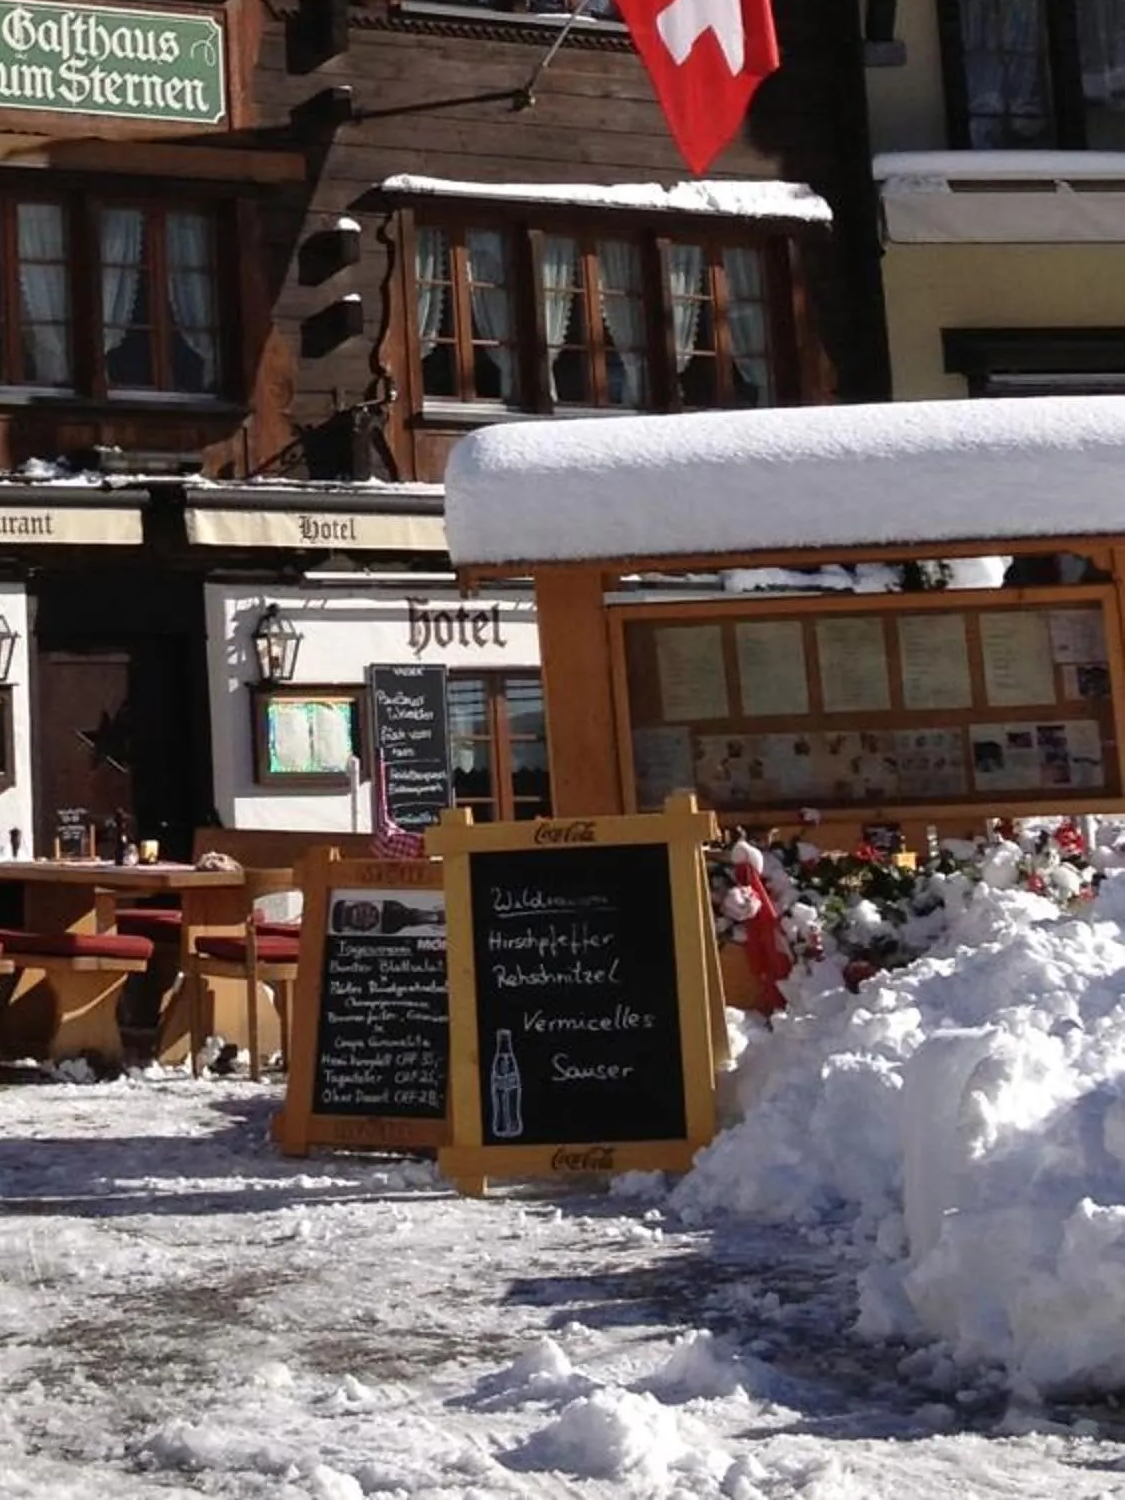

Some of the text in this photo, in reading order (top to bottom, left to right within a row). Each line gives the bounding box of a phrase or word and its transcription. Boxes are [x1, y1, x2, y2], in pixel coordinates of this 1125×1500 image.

[57, 55, 210, 112] Sternen
[298, 514, 357, 543] Hotel
[405, 596, 507, 658] Hotel
[488, 924, 615, 956] Hirschpfeffer
[492, 958, 621, 988] Rehschnitzel
[524, 1005, 656, 1032] Vermicelles
[551, 1053, 635, 1081] Sauser
